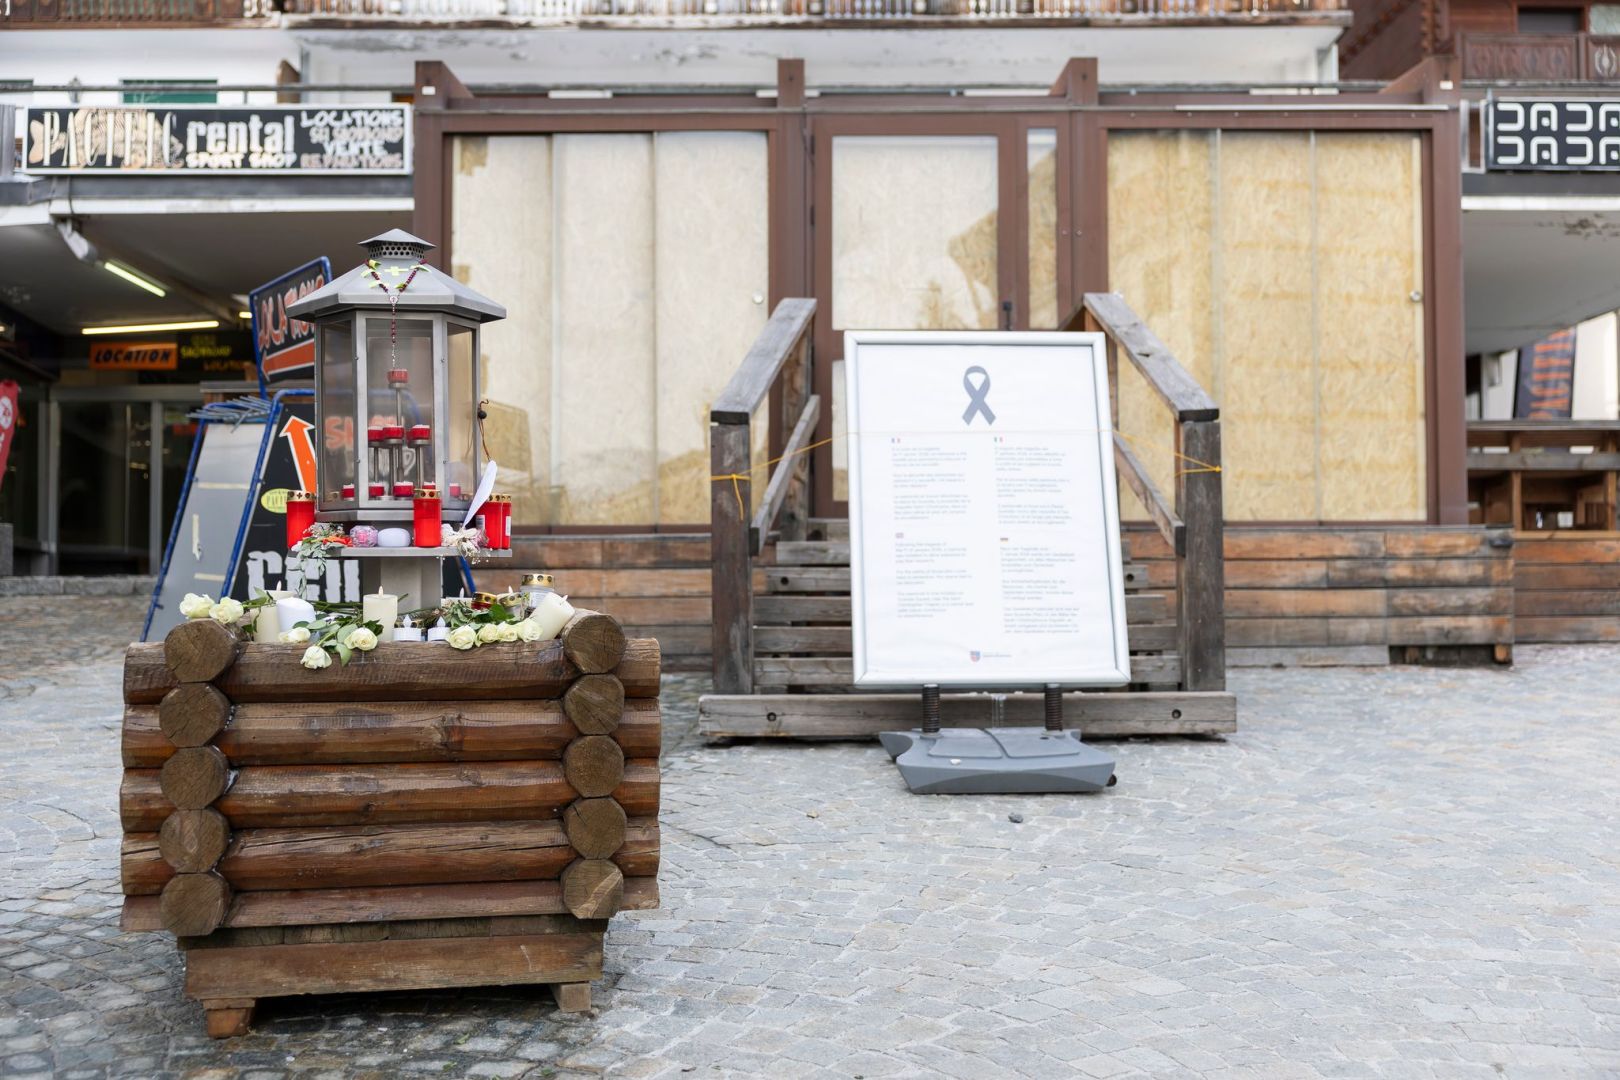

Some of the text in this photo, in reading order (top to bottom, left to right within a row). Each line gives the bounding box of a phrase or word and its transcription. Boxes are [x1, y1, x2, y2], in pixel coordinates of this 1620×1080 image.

[300, 110, 403, 128] LOCATIONS
[43, 111, 178, 167] PACIFIC
[186, 114, 295, 154] rental
[322, 140, 388, 157] VENTE
[186, 152, 297, 168] SPORT SHOP
[95, 350, 171, 363] LOCATION
